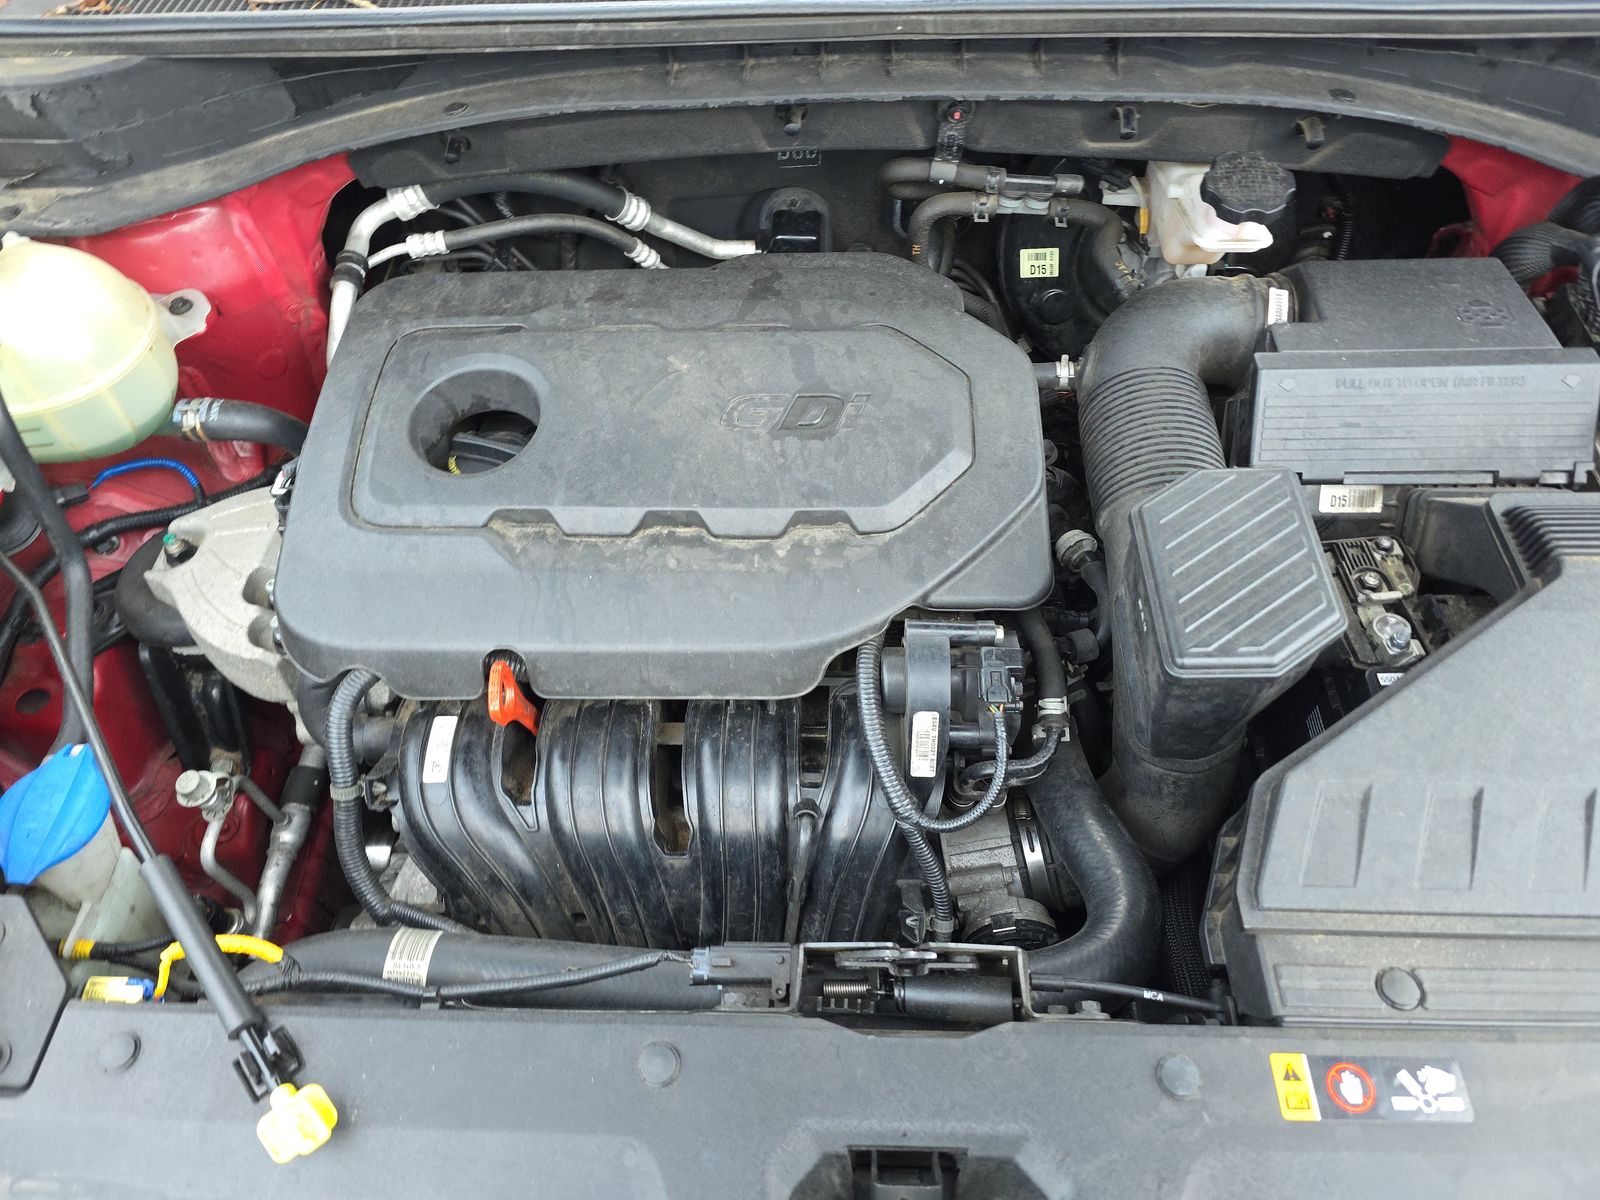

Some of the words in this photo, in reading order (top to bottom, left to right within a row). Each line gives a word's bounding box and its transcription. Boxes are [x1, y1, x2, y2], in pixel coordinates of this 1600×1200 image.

[1030, 264, 1047, 275] D15
[1330, 494, 1348, 507] D15
[1143, 990, 1164, 1002] MCA
